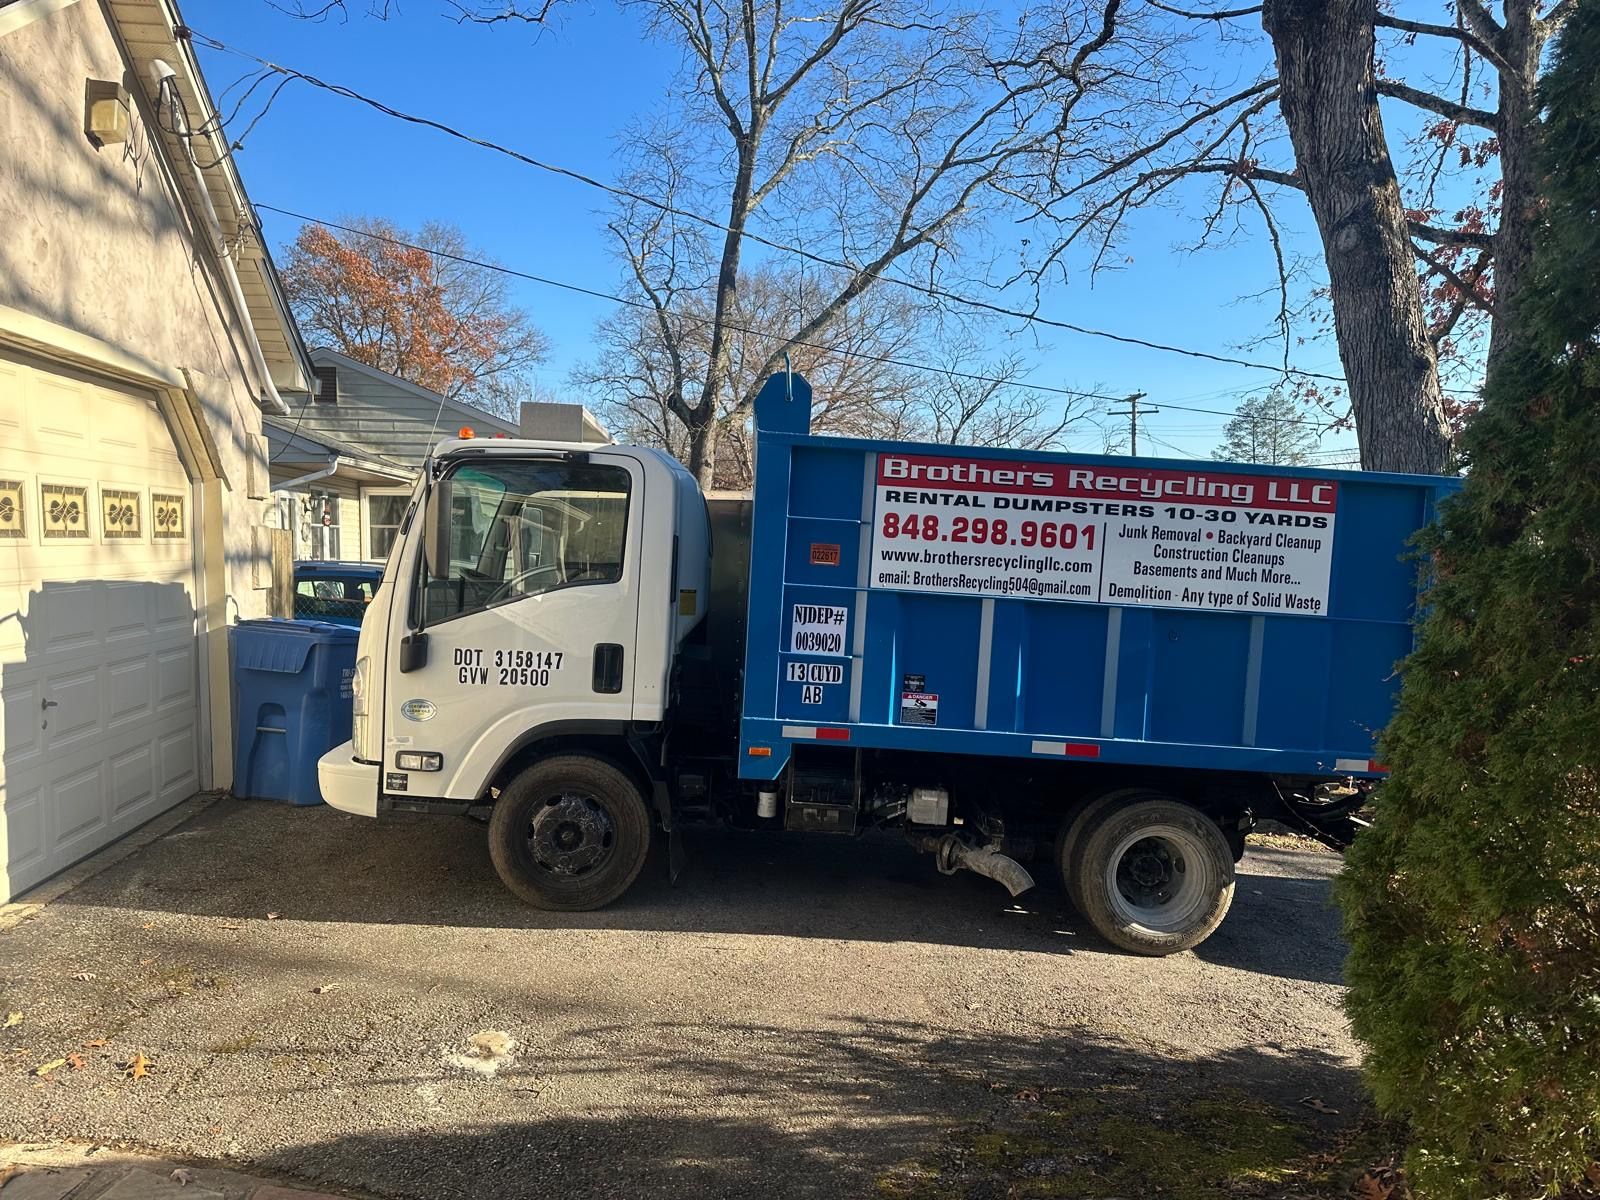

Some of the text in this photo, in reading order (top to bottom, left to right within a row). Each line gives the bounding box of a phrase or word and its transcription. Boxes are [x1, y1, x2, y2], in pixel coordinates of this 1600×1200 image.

[883, 458, 1334, 505] Brothers Recycling LLC
[885, 490, 1328, 529] RENTAL DUMPSTERS 10-30 YARDS
[882, 512, 1096, 551] 848.298.9601
[1118, 523, 1322, 554] Junk Removal Backyard Cleanup
[881, 549, 1093, 574] www.brothersrecyclingllc.com
[1153, 543, 1285, 569] Construction Cleanups
[878, 570, 1091, 596] email: BrothersRecycling504@gmail.com
[1133, 560, 1301, 585] Basements and Much More...
[1108, 582, 1172, 601] Demolition
[1181, 587, 1205, 607] Any
[1208, 590, 1234, 608] type
[1236, 590, 1249, 606] of
[1251, 591, 1282, 608] Solid
[1285, 593, 1321, 610] Waste
[794, 605, 845, 626] NJDEP#
[795, 631, 842, 652] 0039020
[453, 648, 564, 670] DOT 3158147
[458, 666, 550, 687] GVW 20500
[789, 663, 841, 683] 13 CUYD
[802, 687, 823, 704] AB
